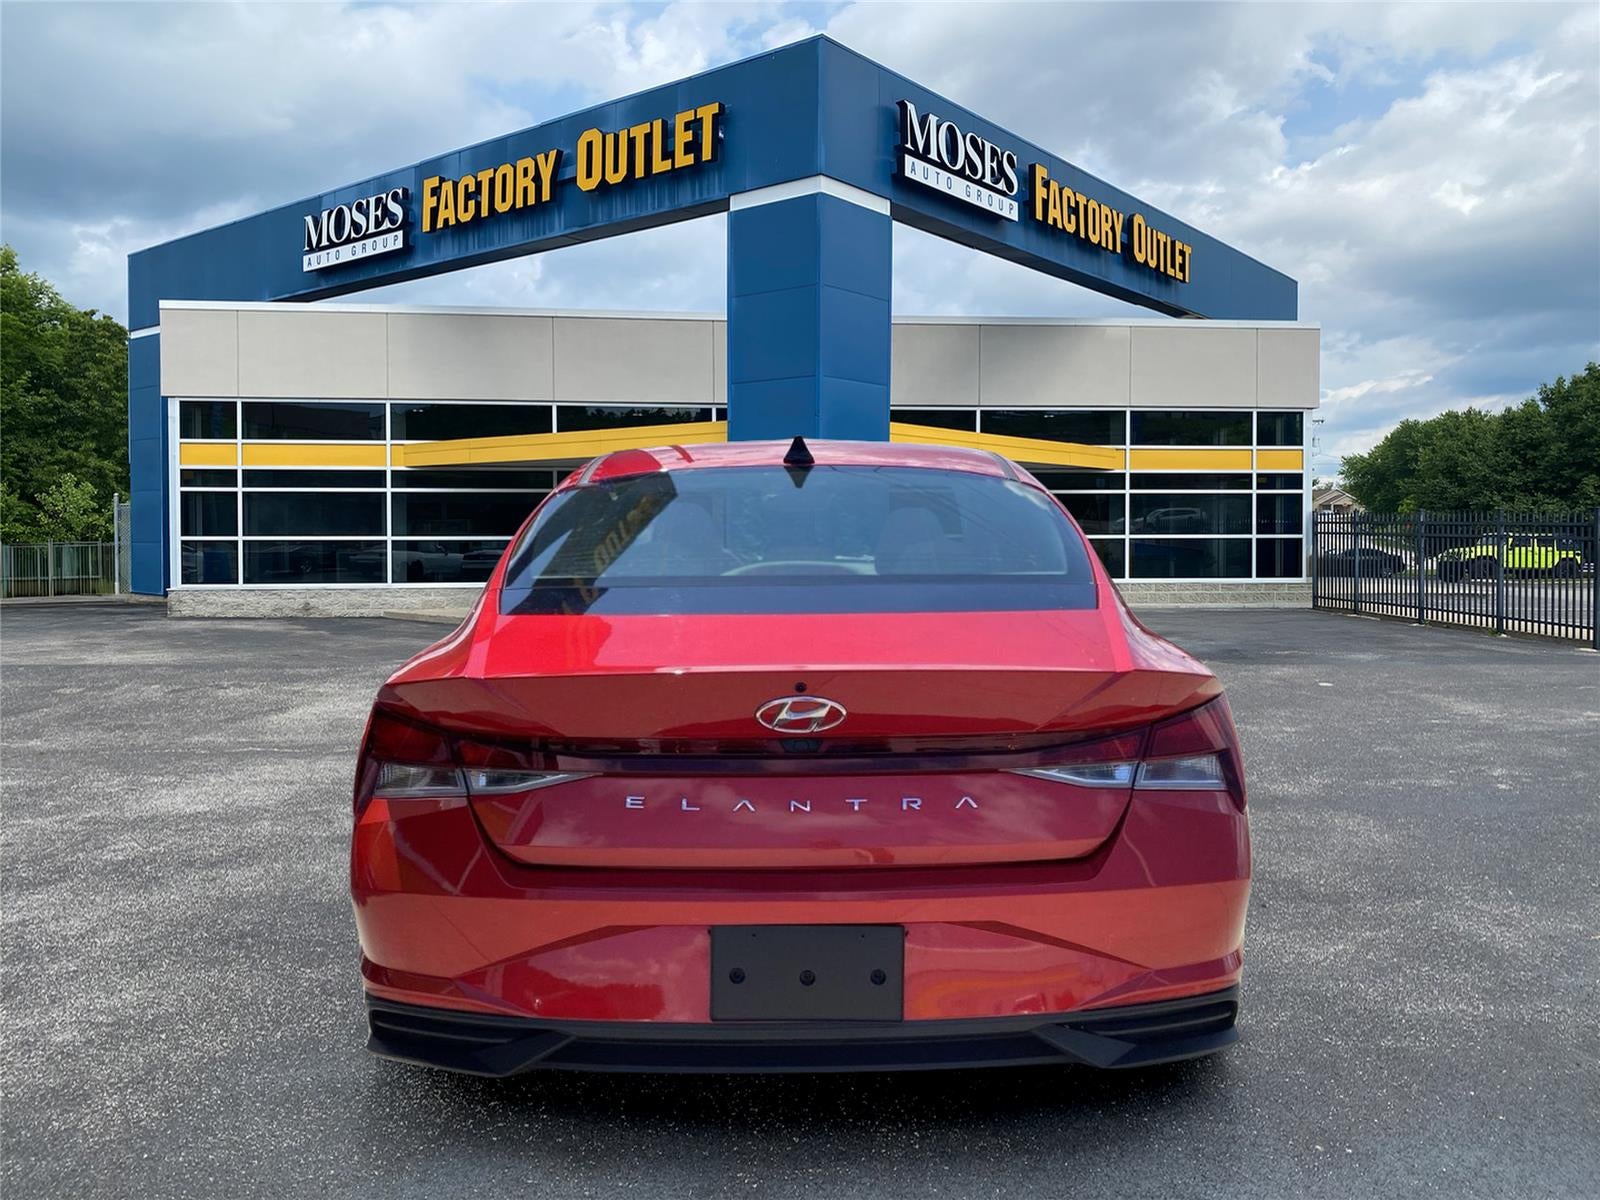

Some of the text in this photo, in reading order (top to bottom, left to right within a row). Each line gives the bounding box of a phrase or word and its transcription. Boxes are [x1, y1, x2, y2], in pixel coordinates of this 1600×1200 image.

[422, 102, 720, 232] FACTORY OUTLET
[903, 99, 1019, 196] MOSES
[303, 187, 404, 251] MOSES
[910, 161, 1014, 215] AUTO GROUP
[307, 234, 399, 268] AUTO GROUP
[1035, 163, 1192, 283] FACTORY OUTLET
[625, 795, 979, 812] ELANTRA
